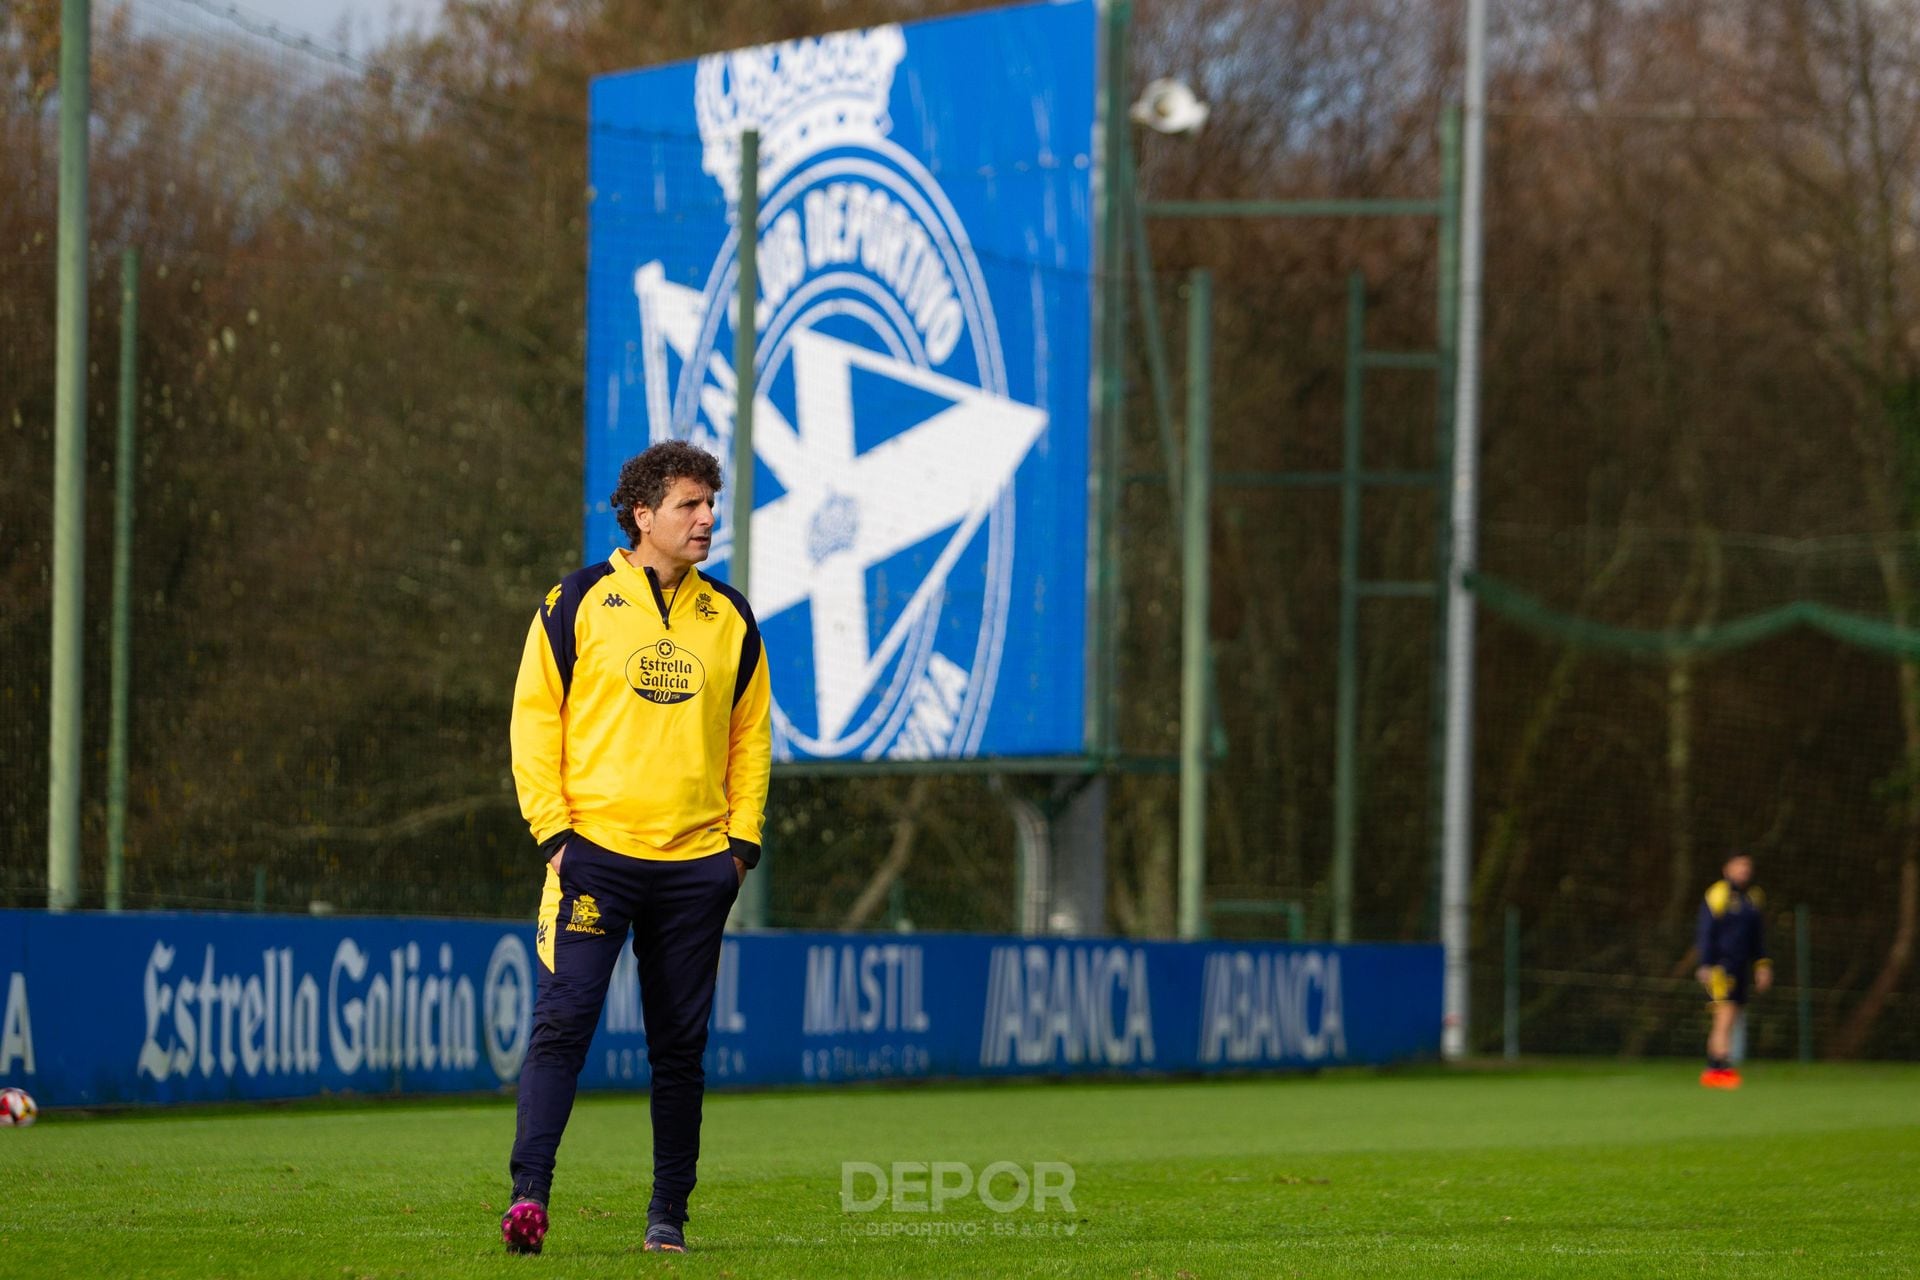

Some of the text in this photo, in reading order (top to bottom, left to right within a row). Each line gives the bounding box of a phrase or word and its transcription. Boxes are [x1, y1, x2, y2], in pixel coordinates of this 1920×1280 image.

[640, 656, 692, 674] Estrella
[640, 671, 689, 689] Galicia
[565, 923, 606, 935] ABANCA
[137, 937, 479, 1082] Estrella Galicia
[803, 945, 930, 1035] MASTIL
[981, 945, 1155, 1066] ABANCA
[1199, 952, 1346, 1061] ABANCA
